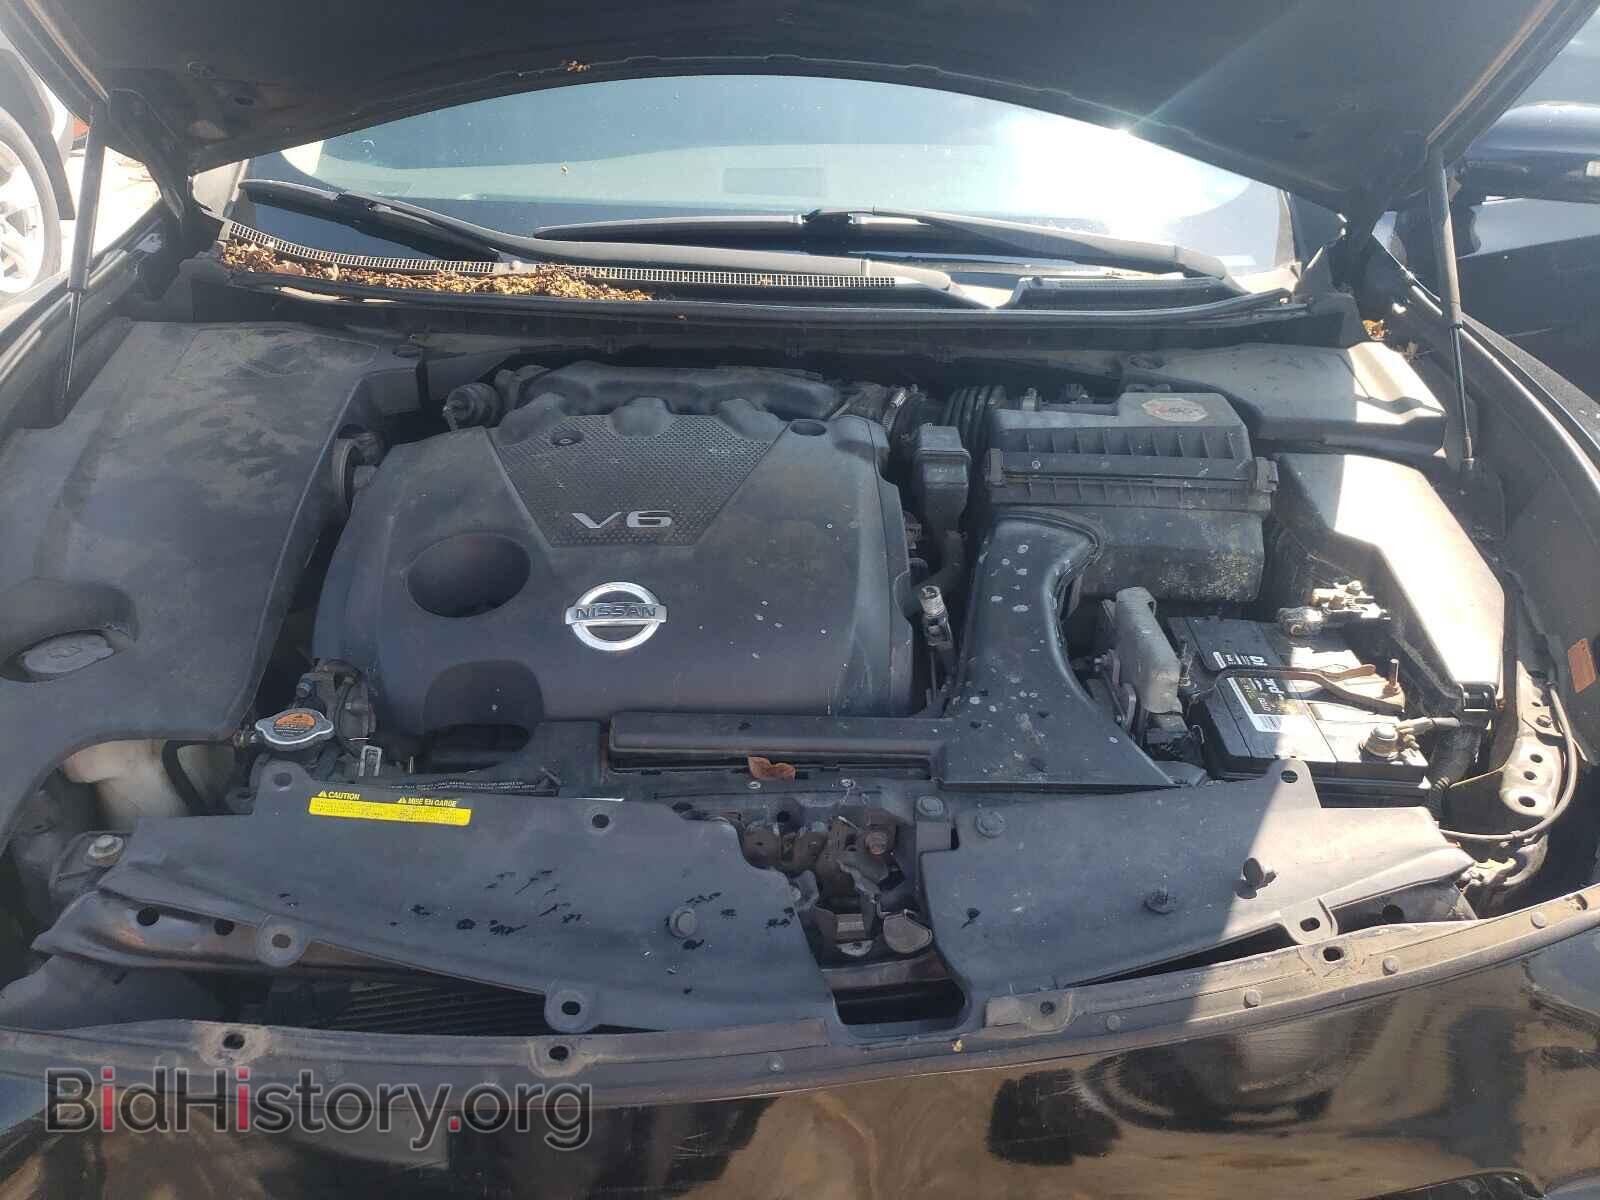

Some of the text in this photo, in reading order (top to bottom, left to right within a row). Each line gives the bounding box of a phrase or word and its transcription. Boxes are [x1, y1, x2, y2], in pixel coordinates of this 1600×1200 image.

[571, 510, 672, 528] V6
[575, 606, 657, 619] NISSAN
[328, 791, 360, 801] CAUTION
[408, 797, 457, 808] MISE EN GARDE
